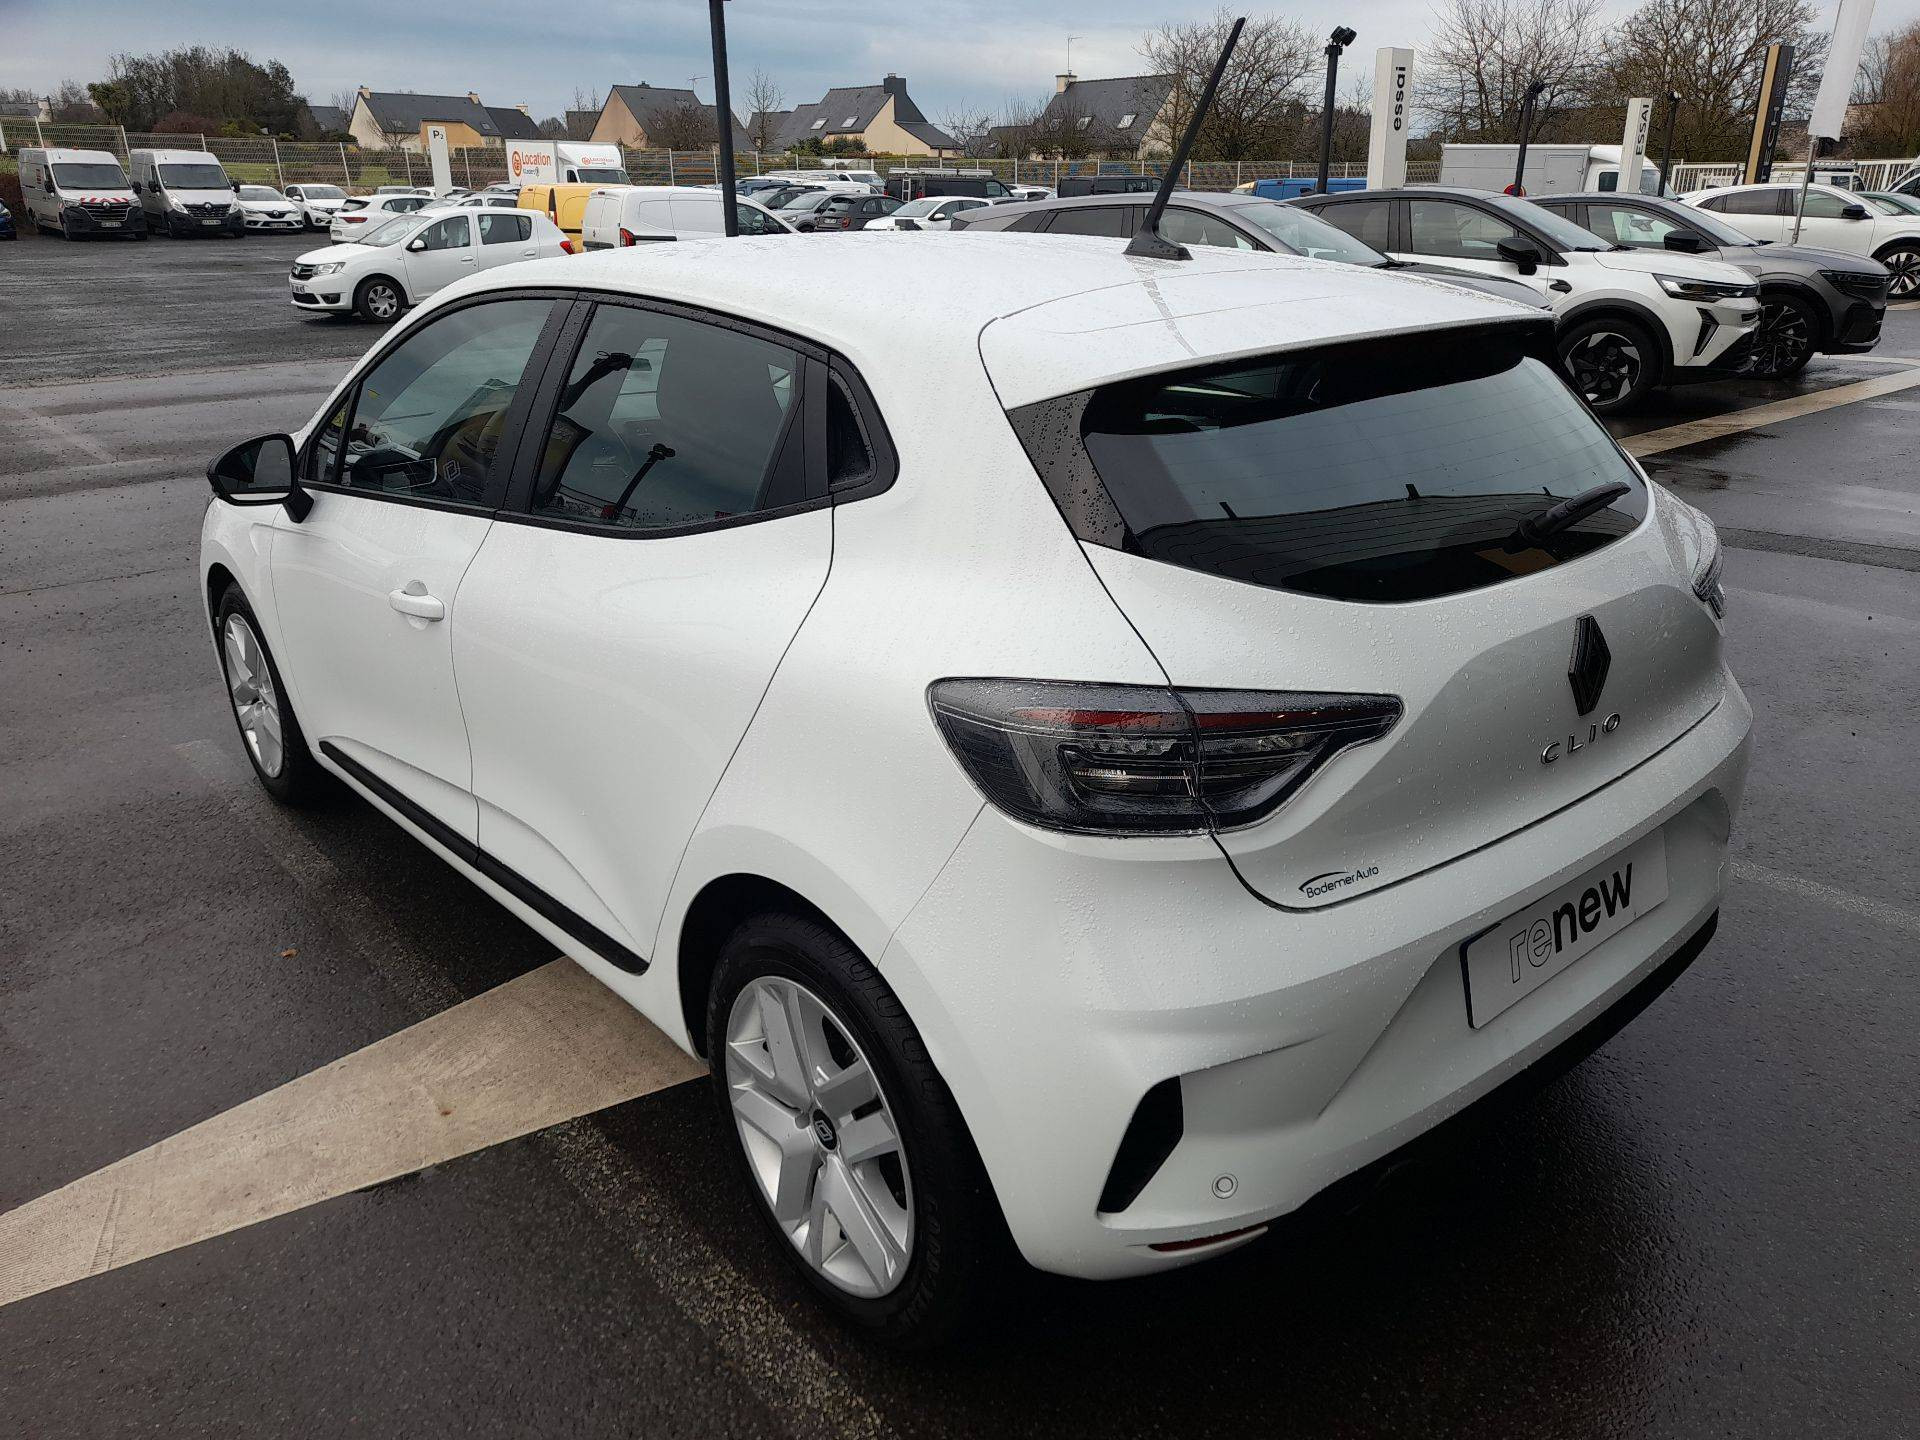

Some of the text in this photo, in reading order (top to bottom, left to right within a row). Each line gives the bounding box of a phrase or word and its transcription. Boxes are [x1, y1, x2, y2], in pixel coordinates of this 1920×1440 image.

[1393, 66, 1406, 131] essai
[1635, 104, 1650, 156] ESSAI
[521, 151, 552, 166] Location
[1541, 712, 1620, 765] CLIO
[1509, 862, 1633, 984] renew
